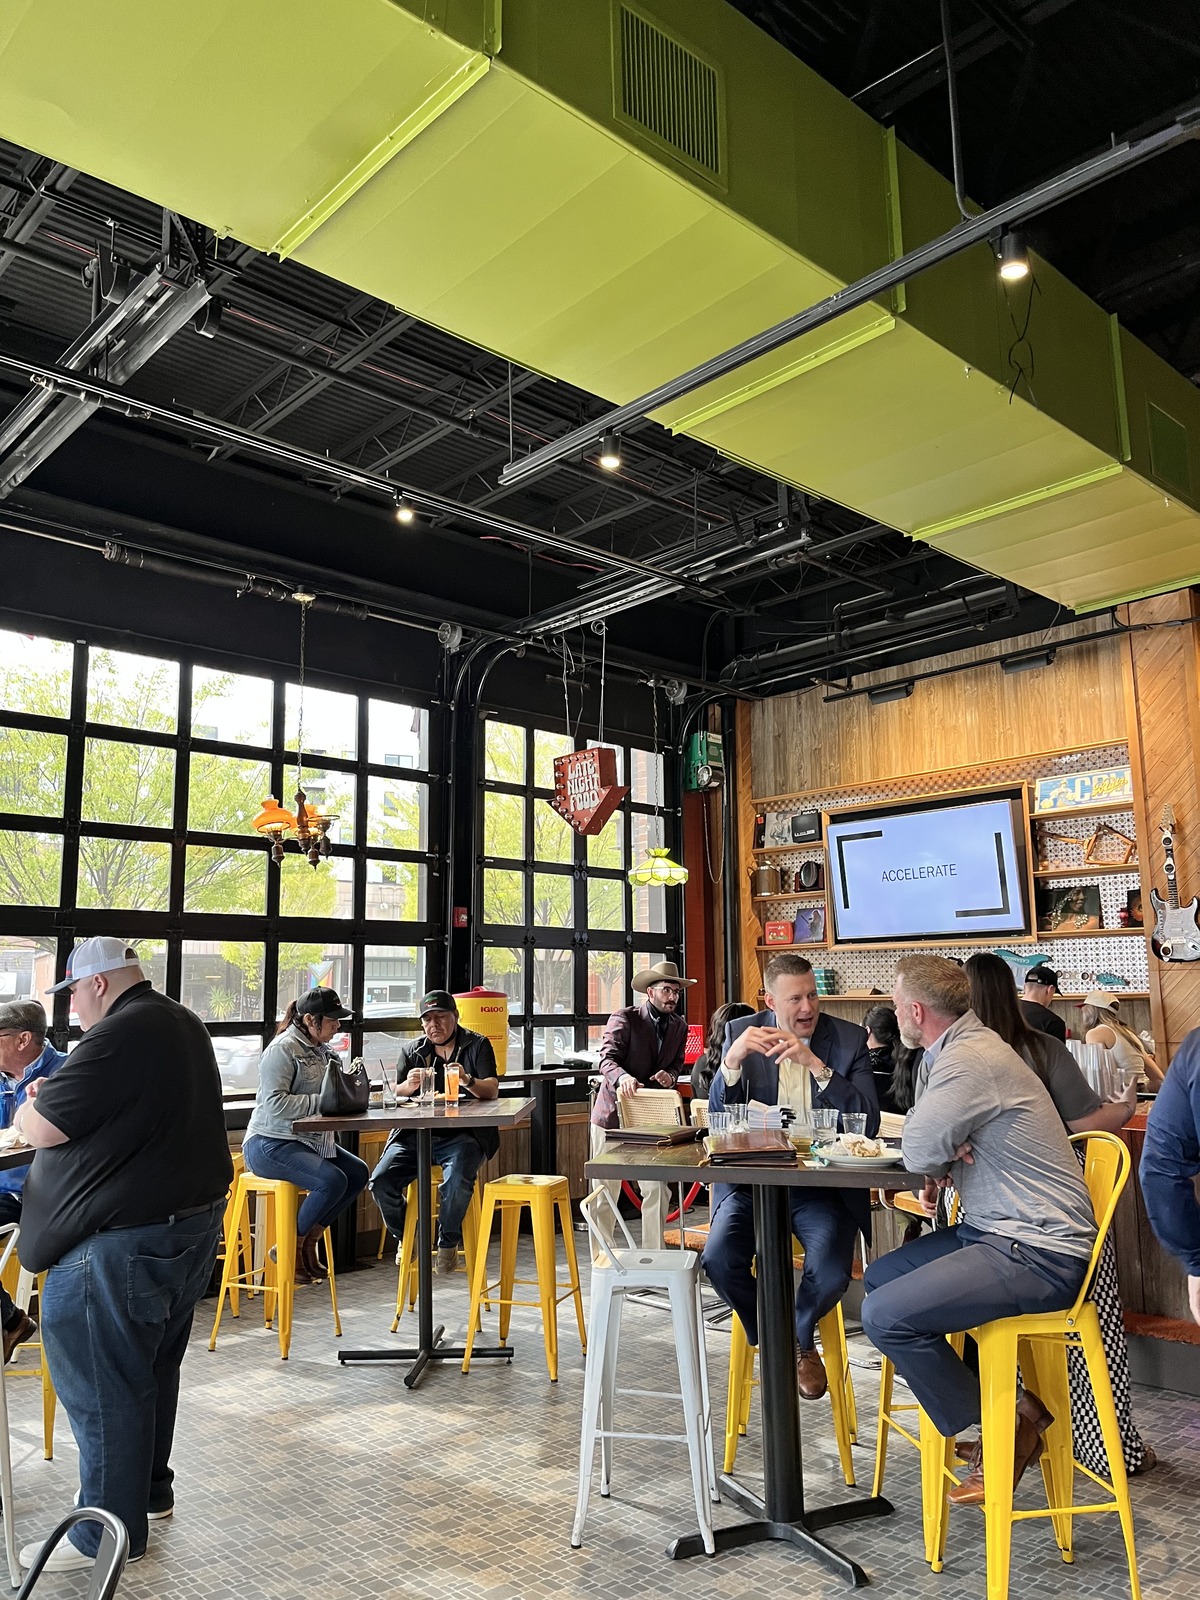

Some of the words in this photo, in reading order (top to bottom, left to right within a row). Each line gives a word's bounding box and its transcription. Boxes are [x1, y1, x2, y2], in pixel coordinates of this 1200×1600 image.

[568, 759, 596, 780] LATE
[566, 773, 601, 796] NIGHT
[570, 789, 601, 812] FOOD
[881, 863, 958, 882] ACCELERATE
